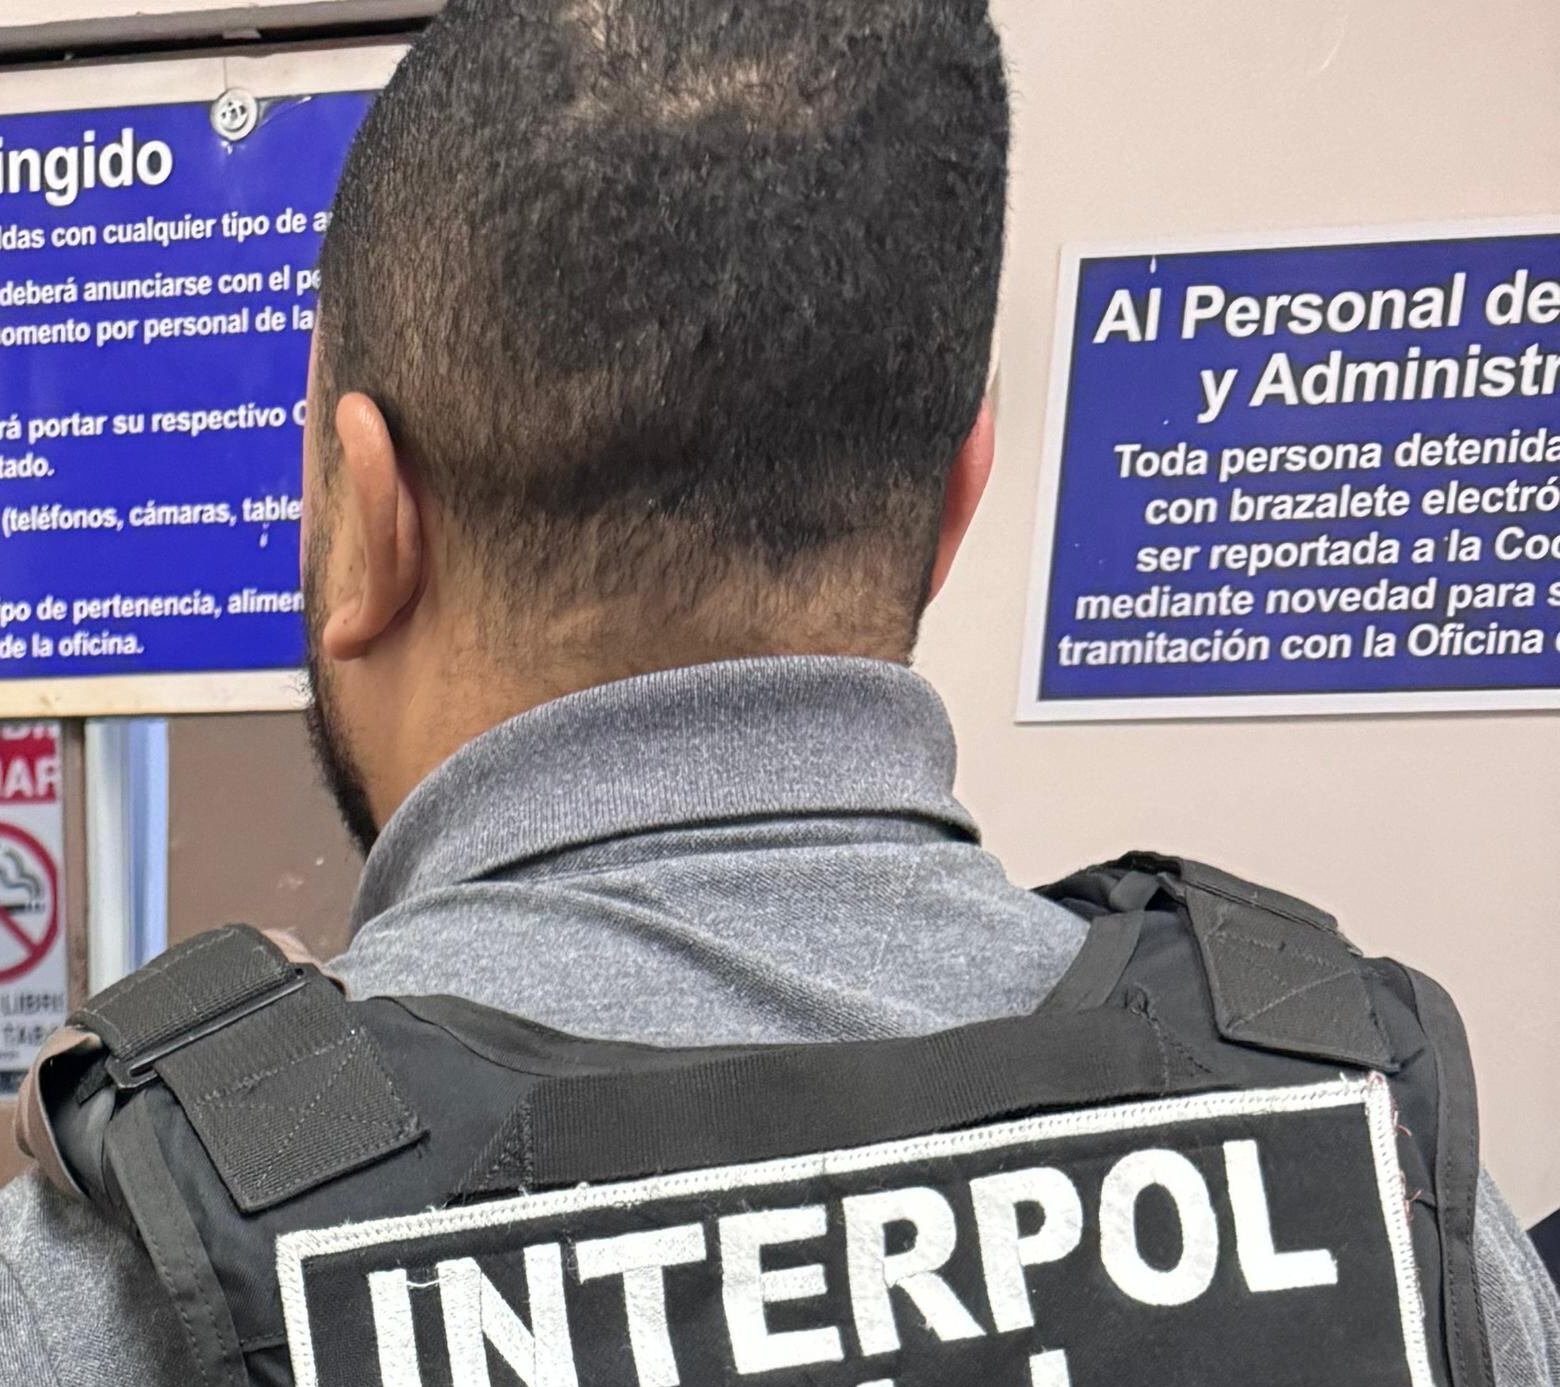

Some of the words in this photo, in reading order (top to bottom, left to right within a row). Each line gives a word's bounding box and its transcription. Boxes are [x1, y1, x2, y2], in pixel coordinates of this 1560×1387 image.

[50, 225, 97, 248] con
[102, 213, 217, 247] cualquier
[221, 210, 270, 243] tipo
[277, 207, 308, 234] de
[83, 272, 213, 302] anunciarse
[217, 272, 263, 294] con
[268, 264, 291, 292] el
[96, 319, 140, 347] por
[143, 307, 249, 345] personal
[254, 305, 287, 333] de
[292, 304, 313, 330] la
[1092, 287, 1162, 344] Al
[1181, 272, 1467, 340] Personal
[1485, 269, 1560, 326] de
[1197, 368, 1239, 424] y
[28, 412, 108, 445] portar
[112, 414, 145, 435] su
[151, 402, 287, 437] respectivo
[1113, 441, 1209, 478] Toda
[1218, 442, 1383, 483] persona
[1394, 427, 1560, 468] detenida
[1, 503, 124, 538] (teléfonos,
[128, 500, 237, 527] cámaras,
[242, 495, 303, 522] table
[1144, 497, 1218, 525] con
[1229, 483, 1411, 522] brazalete
[1136, 545, 1201, 573] ser
[1209, 531, 1401, 577] reportada
[1411, 537, 1436, 564] a
[1448, 528, 1482, 562] la
[36, 595, 68, 621] de
[72, 590, 222, 625] pertenencia,
[1075, 584, 1255, 620] mediante
[1265, 576, 1438, 614] novedad
[1446, 582, 1536, 618] para
[31, 633, 54, 658] la
[57, 631, 144, 657] oficina.
[1058, 628, 1271, 666] tramitación
[1280, 633, 1352, 660] con
[1363, 625, 1397, 658] la
[1407, 621, 1545, 657] Oficina
